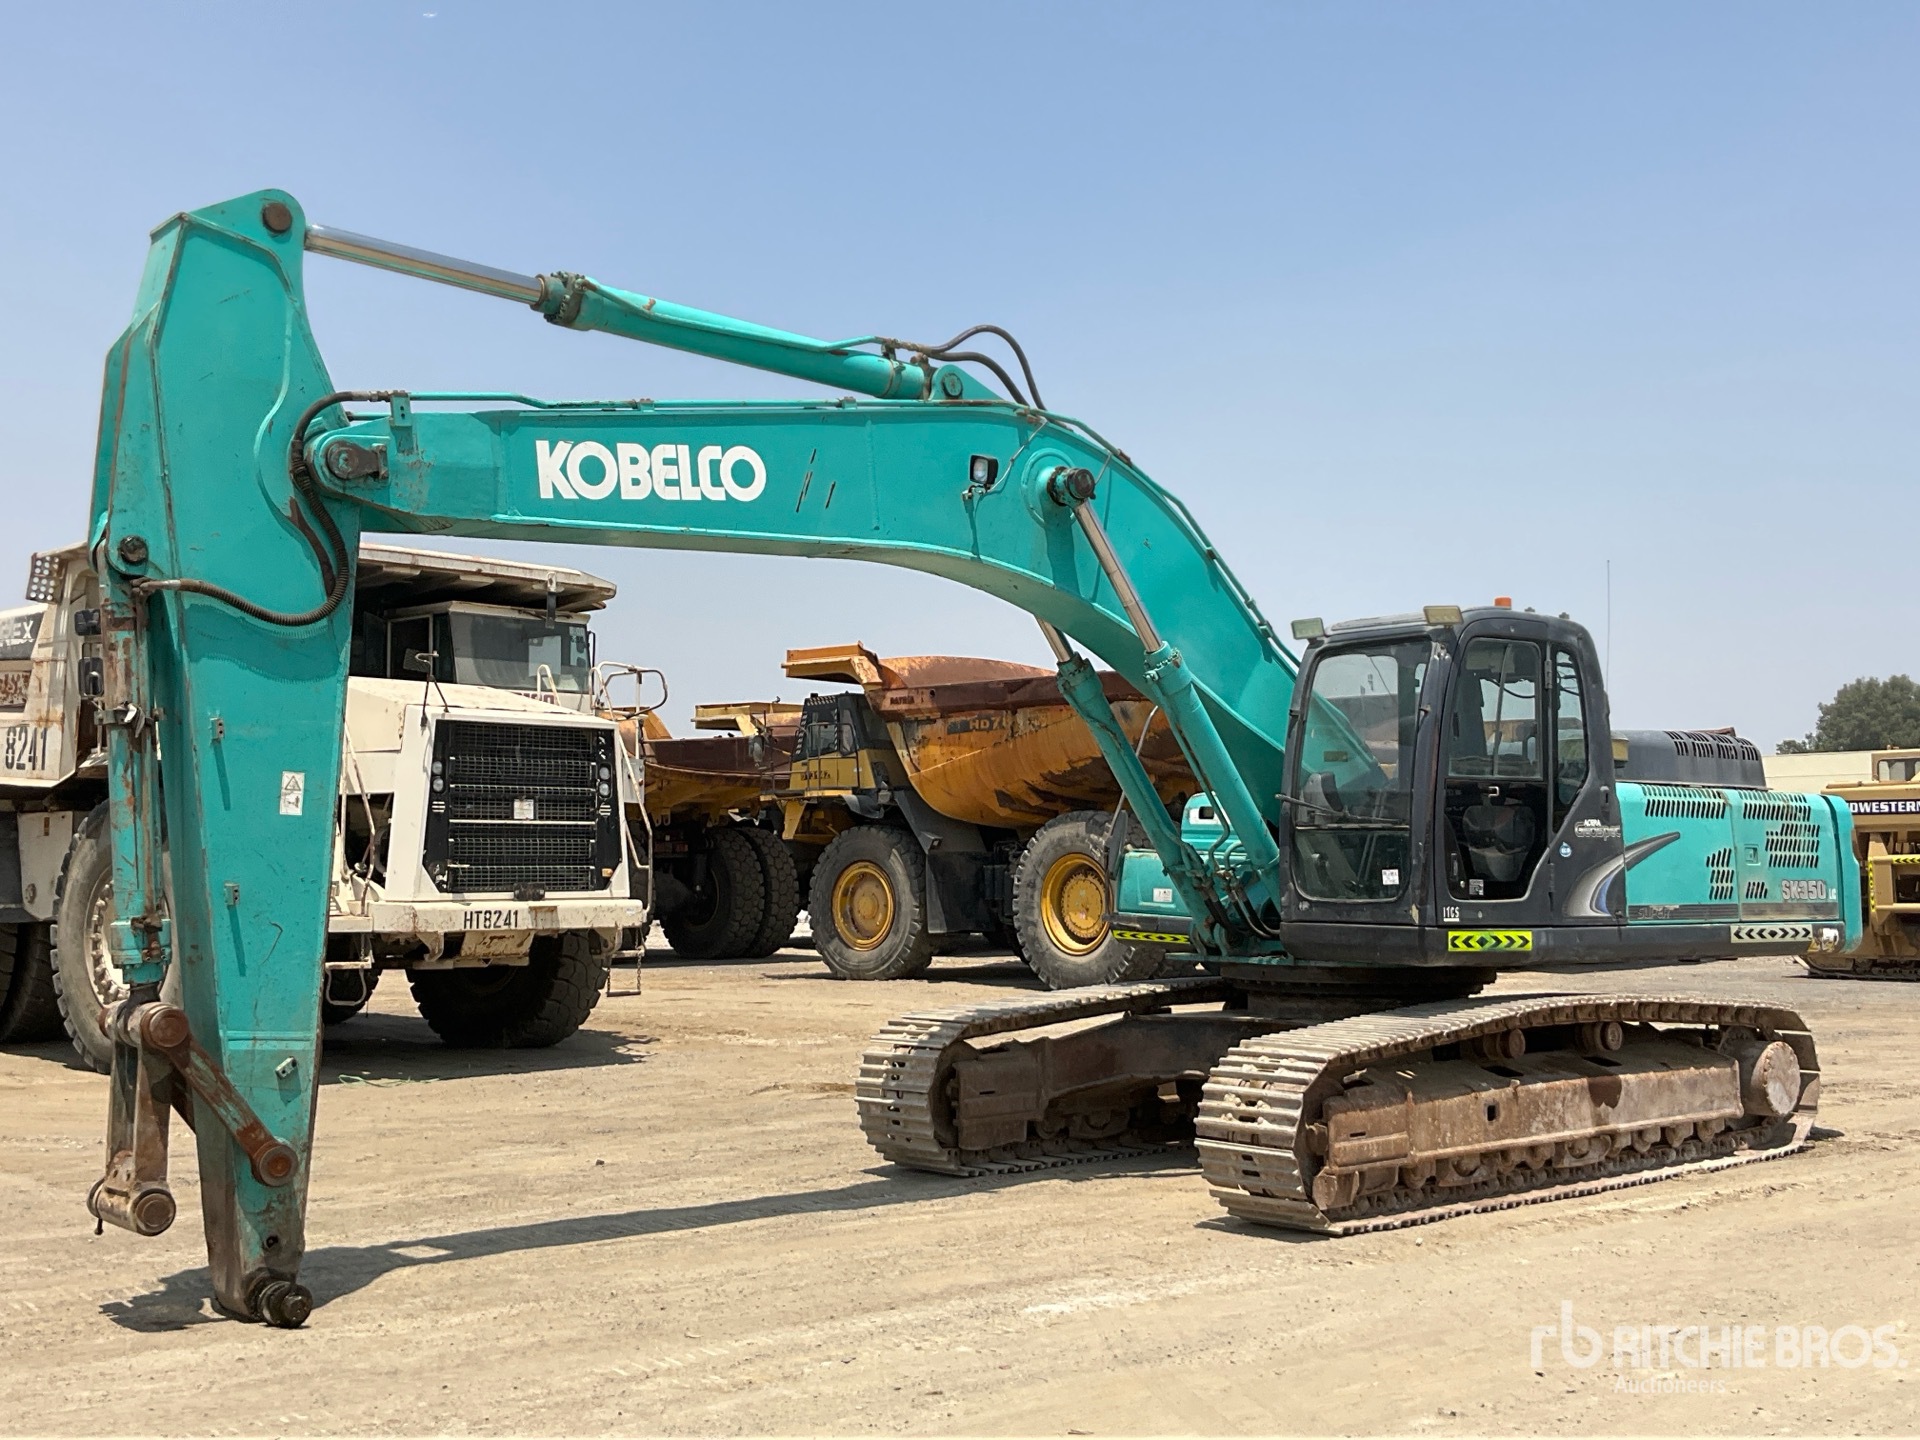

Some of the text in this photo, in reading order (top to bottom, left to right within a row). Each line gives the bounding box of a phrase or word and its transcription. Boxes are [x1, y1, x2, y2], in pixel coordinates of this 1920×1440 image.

[535, 440, 767, 502] KOBELCO
[5, 725, 48, 770] 8241
[1828, 888, 1837, 900] LC
[463, 909, 519, 930] HT8241
